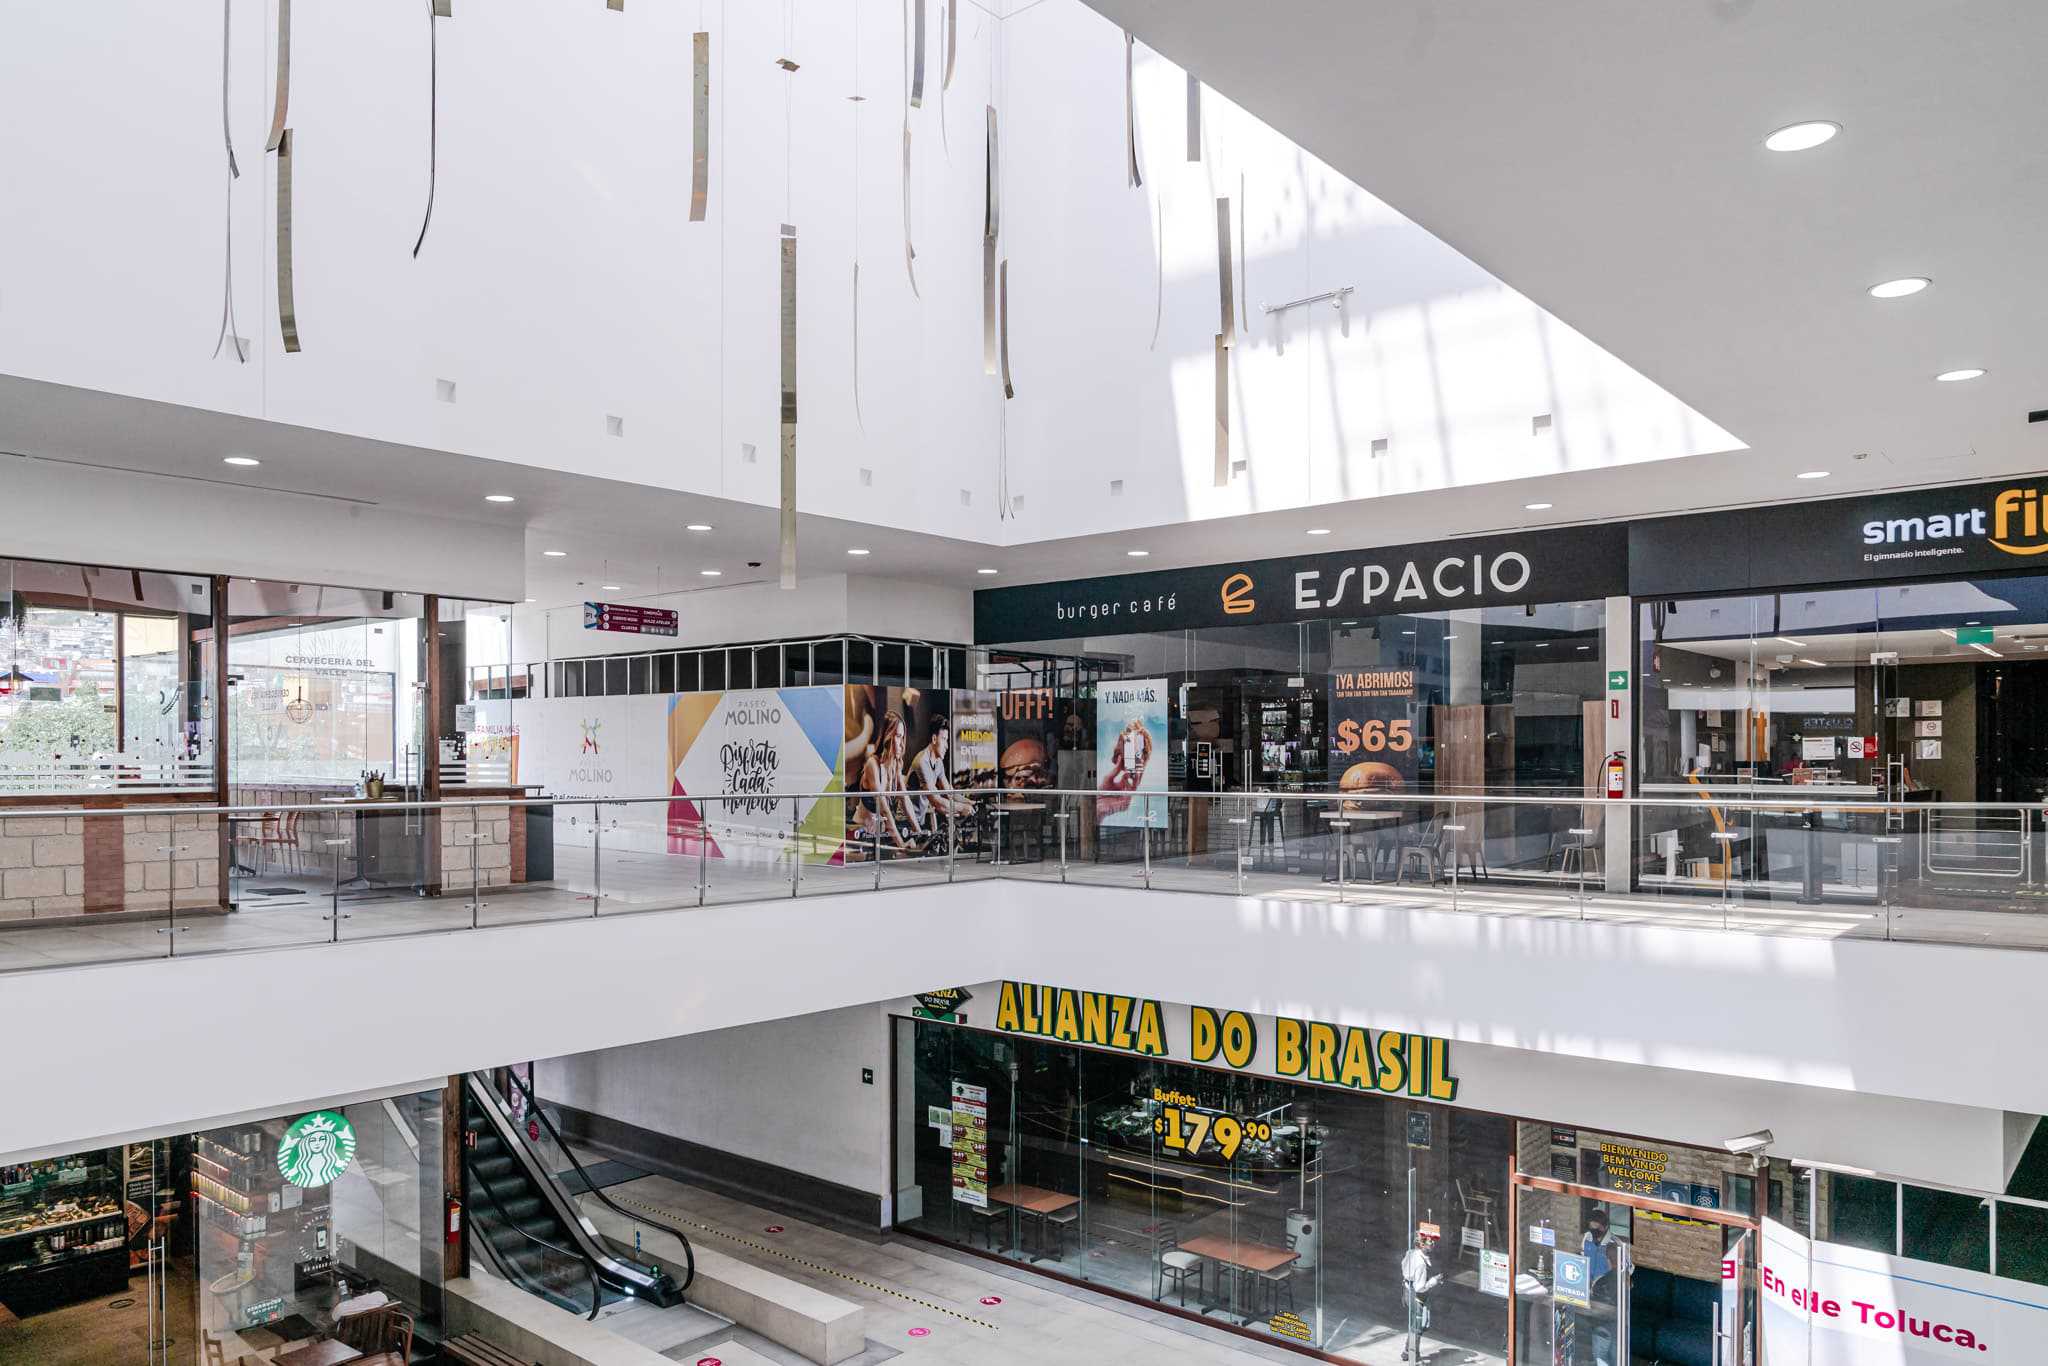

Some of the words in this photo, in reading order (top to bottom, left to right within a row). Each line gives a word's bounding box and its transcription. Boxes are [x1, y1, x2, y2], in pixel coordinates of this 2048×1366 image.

[1863, 508, 1986, 544] smart
[1864, 553, 1873, 561] El
[1873, 551, 1913, 562] gimnasio
[1915, 547, 1965, 557] inteligente.
[1295, 551, 1531, 610] ESPACIO
[1057, 601, 1121, 620] burger
[1130, 593, 1177, 613] café
[356, 657, 376, 667] DEL
[1335, 673, 1354, 690] ¡YA
[1357, 671, 1413, 689] ABRIMOS!
[1002, 687, 1054, 720] UFFF!
[1105, 691, 1111, 704] Y
[724, 709, 781, 725] MOLINO
[1337, 718, 1413, 756] $65
[720, 738, 779, 775] Disfruta
[568, 768, 614, 783] MOLINO
[733, 766, 767, 794] Cada
[997, 981, 1168, 1056] ALIANZA
[1190, 1006, 1255, 1069] DO
[1276, 1016, 1458, 1101] BRASIL
[1153, 1088, 1197, 1108] Buffet:
[1601, 1143, 1668, 1162] BIENVENIDO
[1602, 1154, 1665, 1173] BEM-VINDO
[1607, 1165, 1661, 1183] WELCOME
[1614, 1180, 1655, 1194] ようこそ
[1556, 1285, 1585, 1297] ENTRADA
[1763, 1266, 1785, 1297] En
[1852, 1301, 1987, 1352] Toluca.
